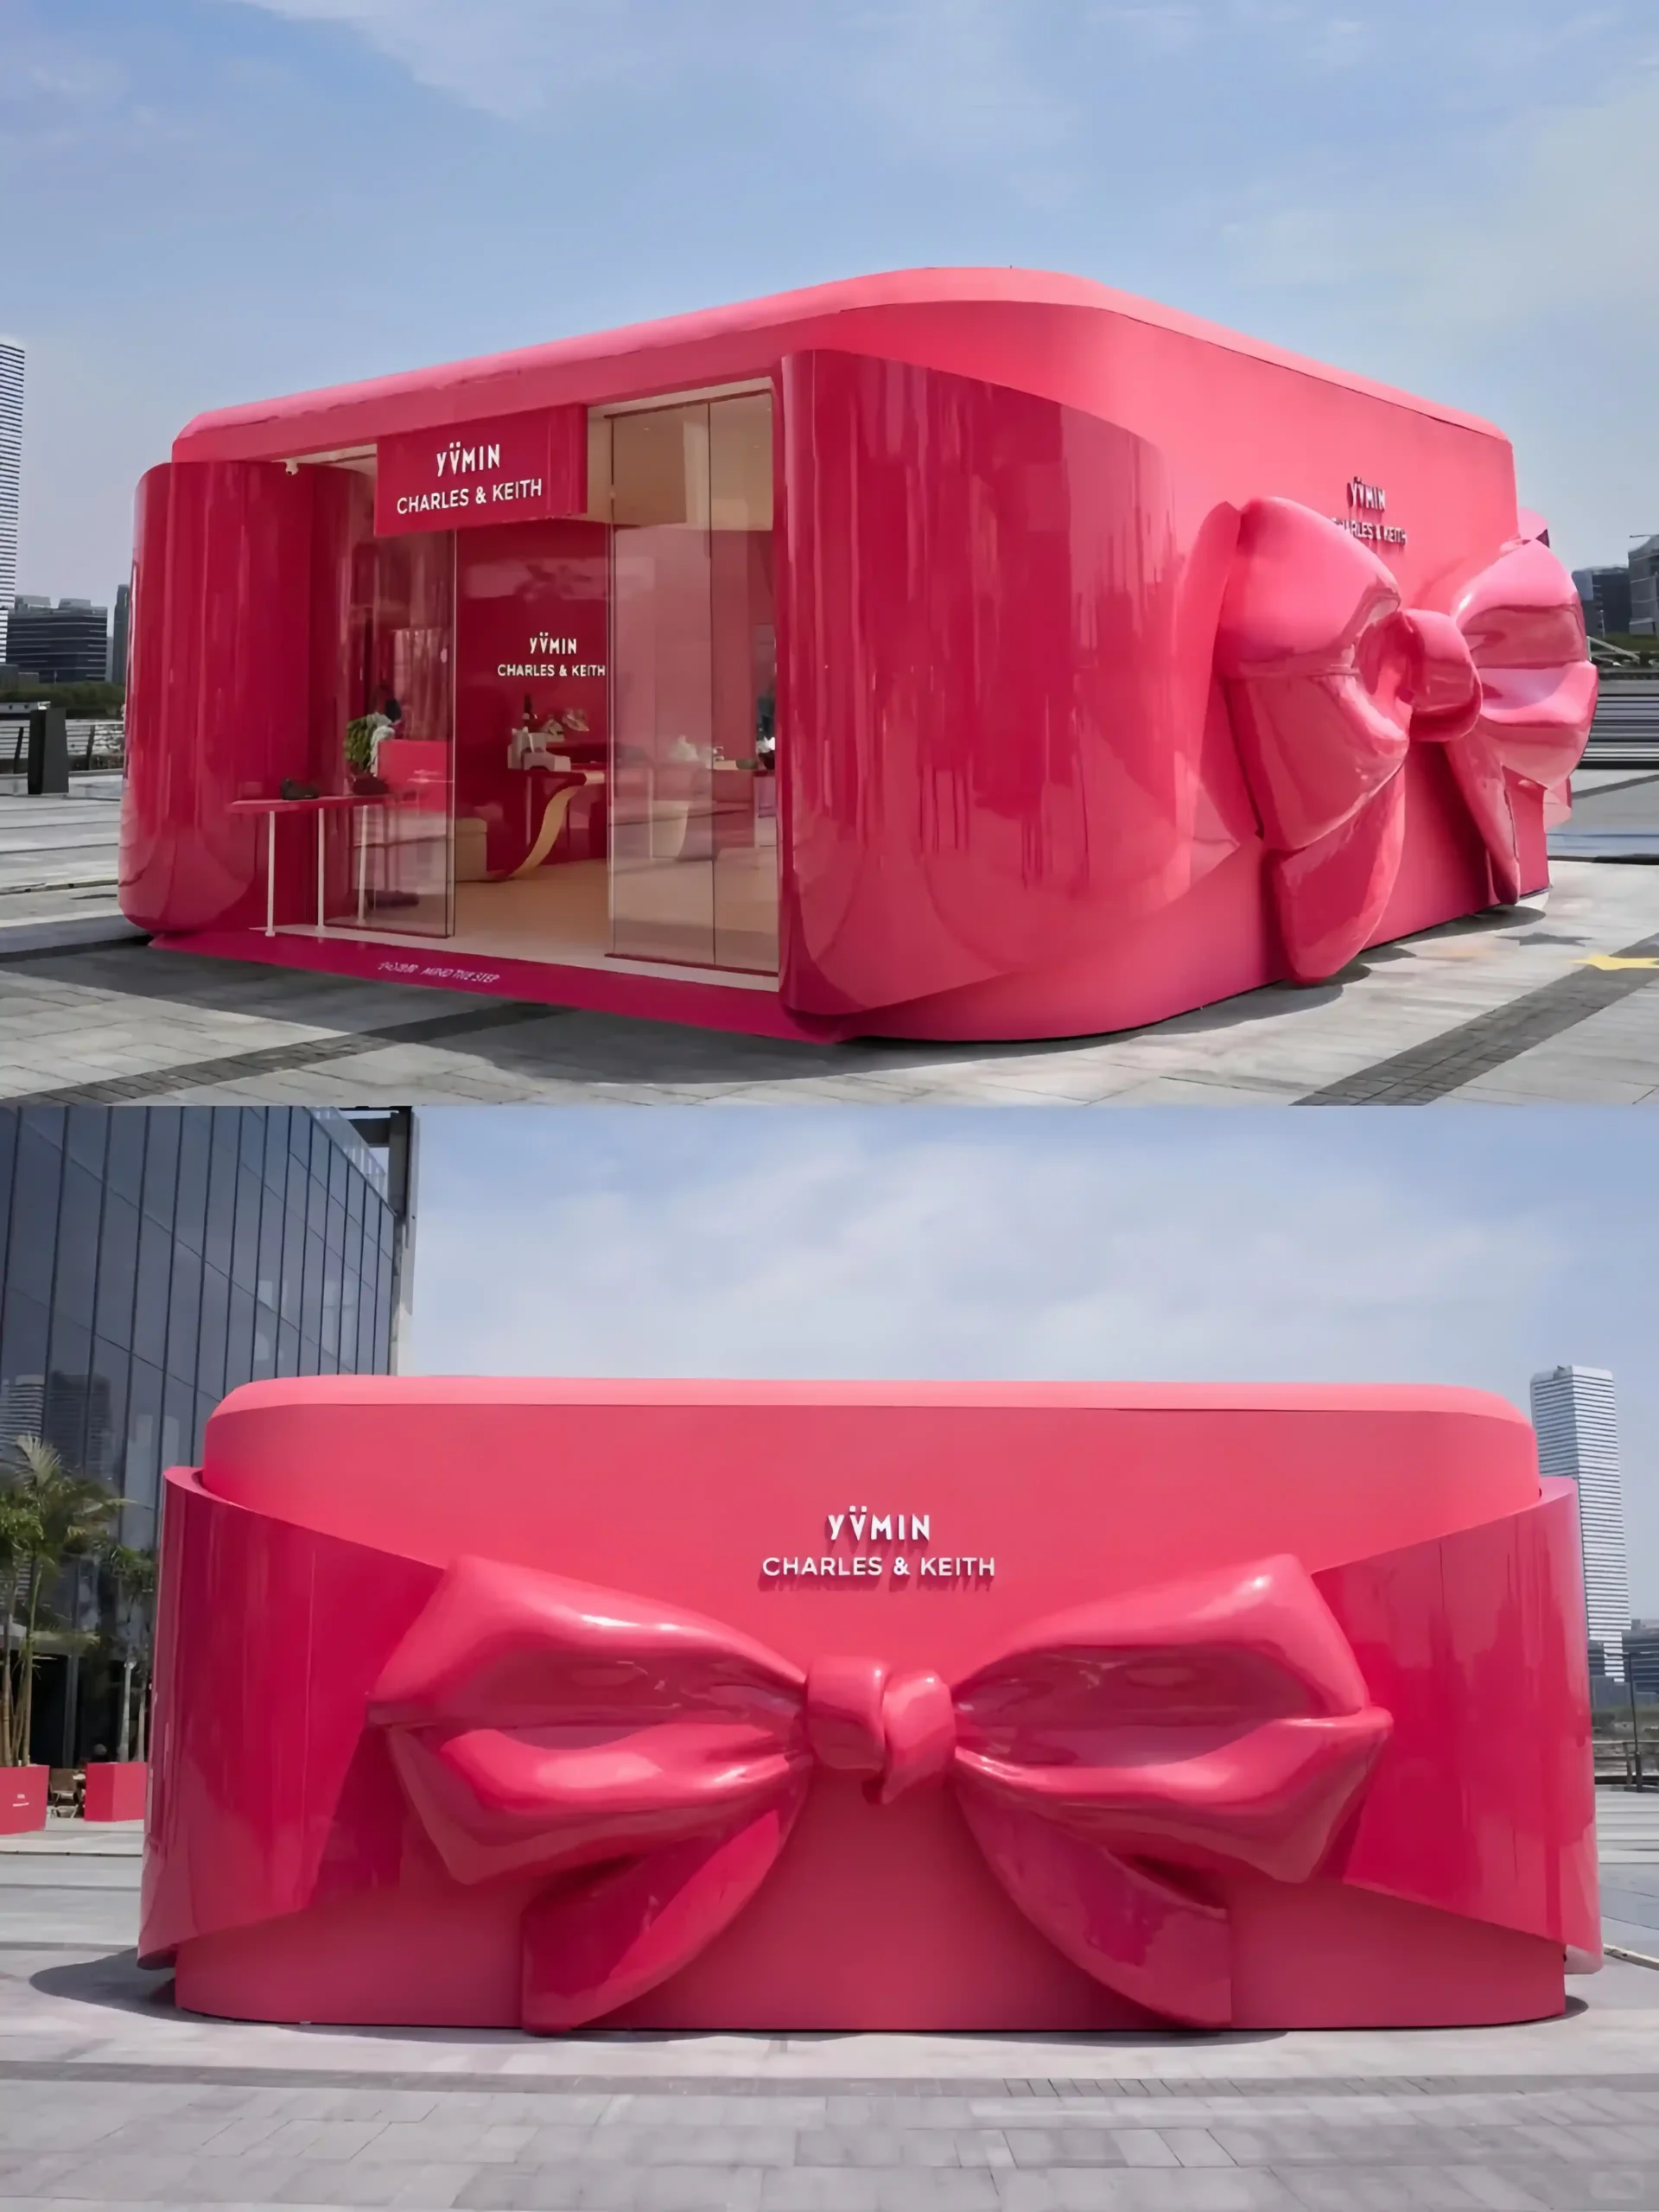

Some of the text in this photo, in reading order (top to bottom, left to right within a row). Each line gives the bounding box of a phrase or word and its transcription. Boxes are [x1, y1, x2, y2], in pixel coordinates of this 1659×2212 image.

[397, 478, 542, 514] CHARLES & KEITH
[498, 664, 605, 677] CHARLES & KEITH
[420, 967, 454, 977] MIND
[471, 973, 500, 983] STEP
[762, 1556, 995, 1576] CHARLES & KEITH
